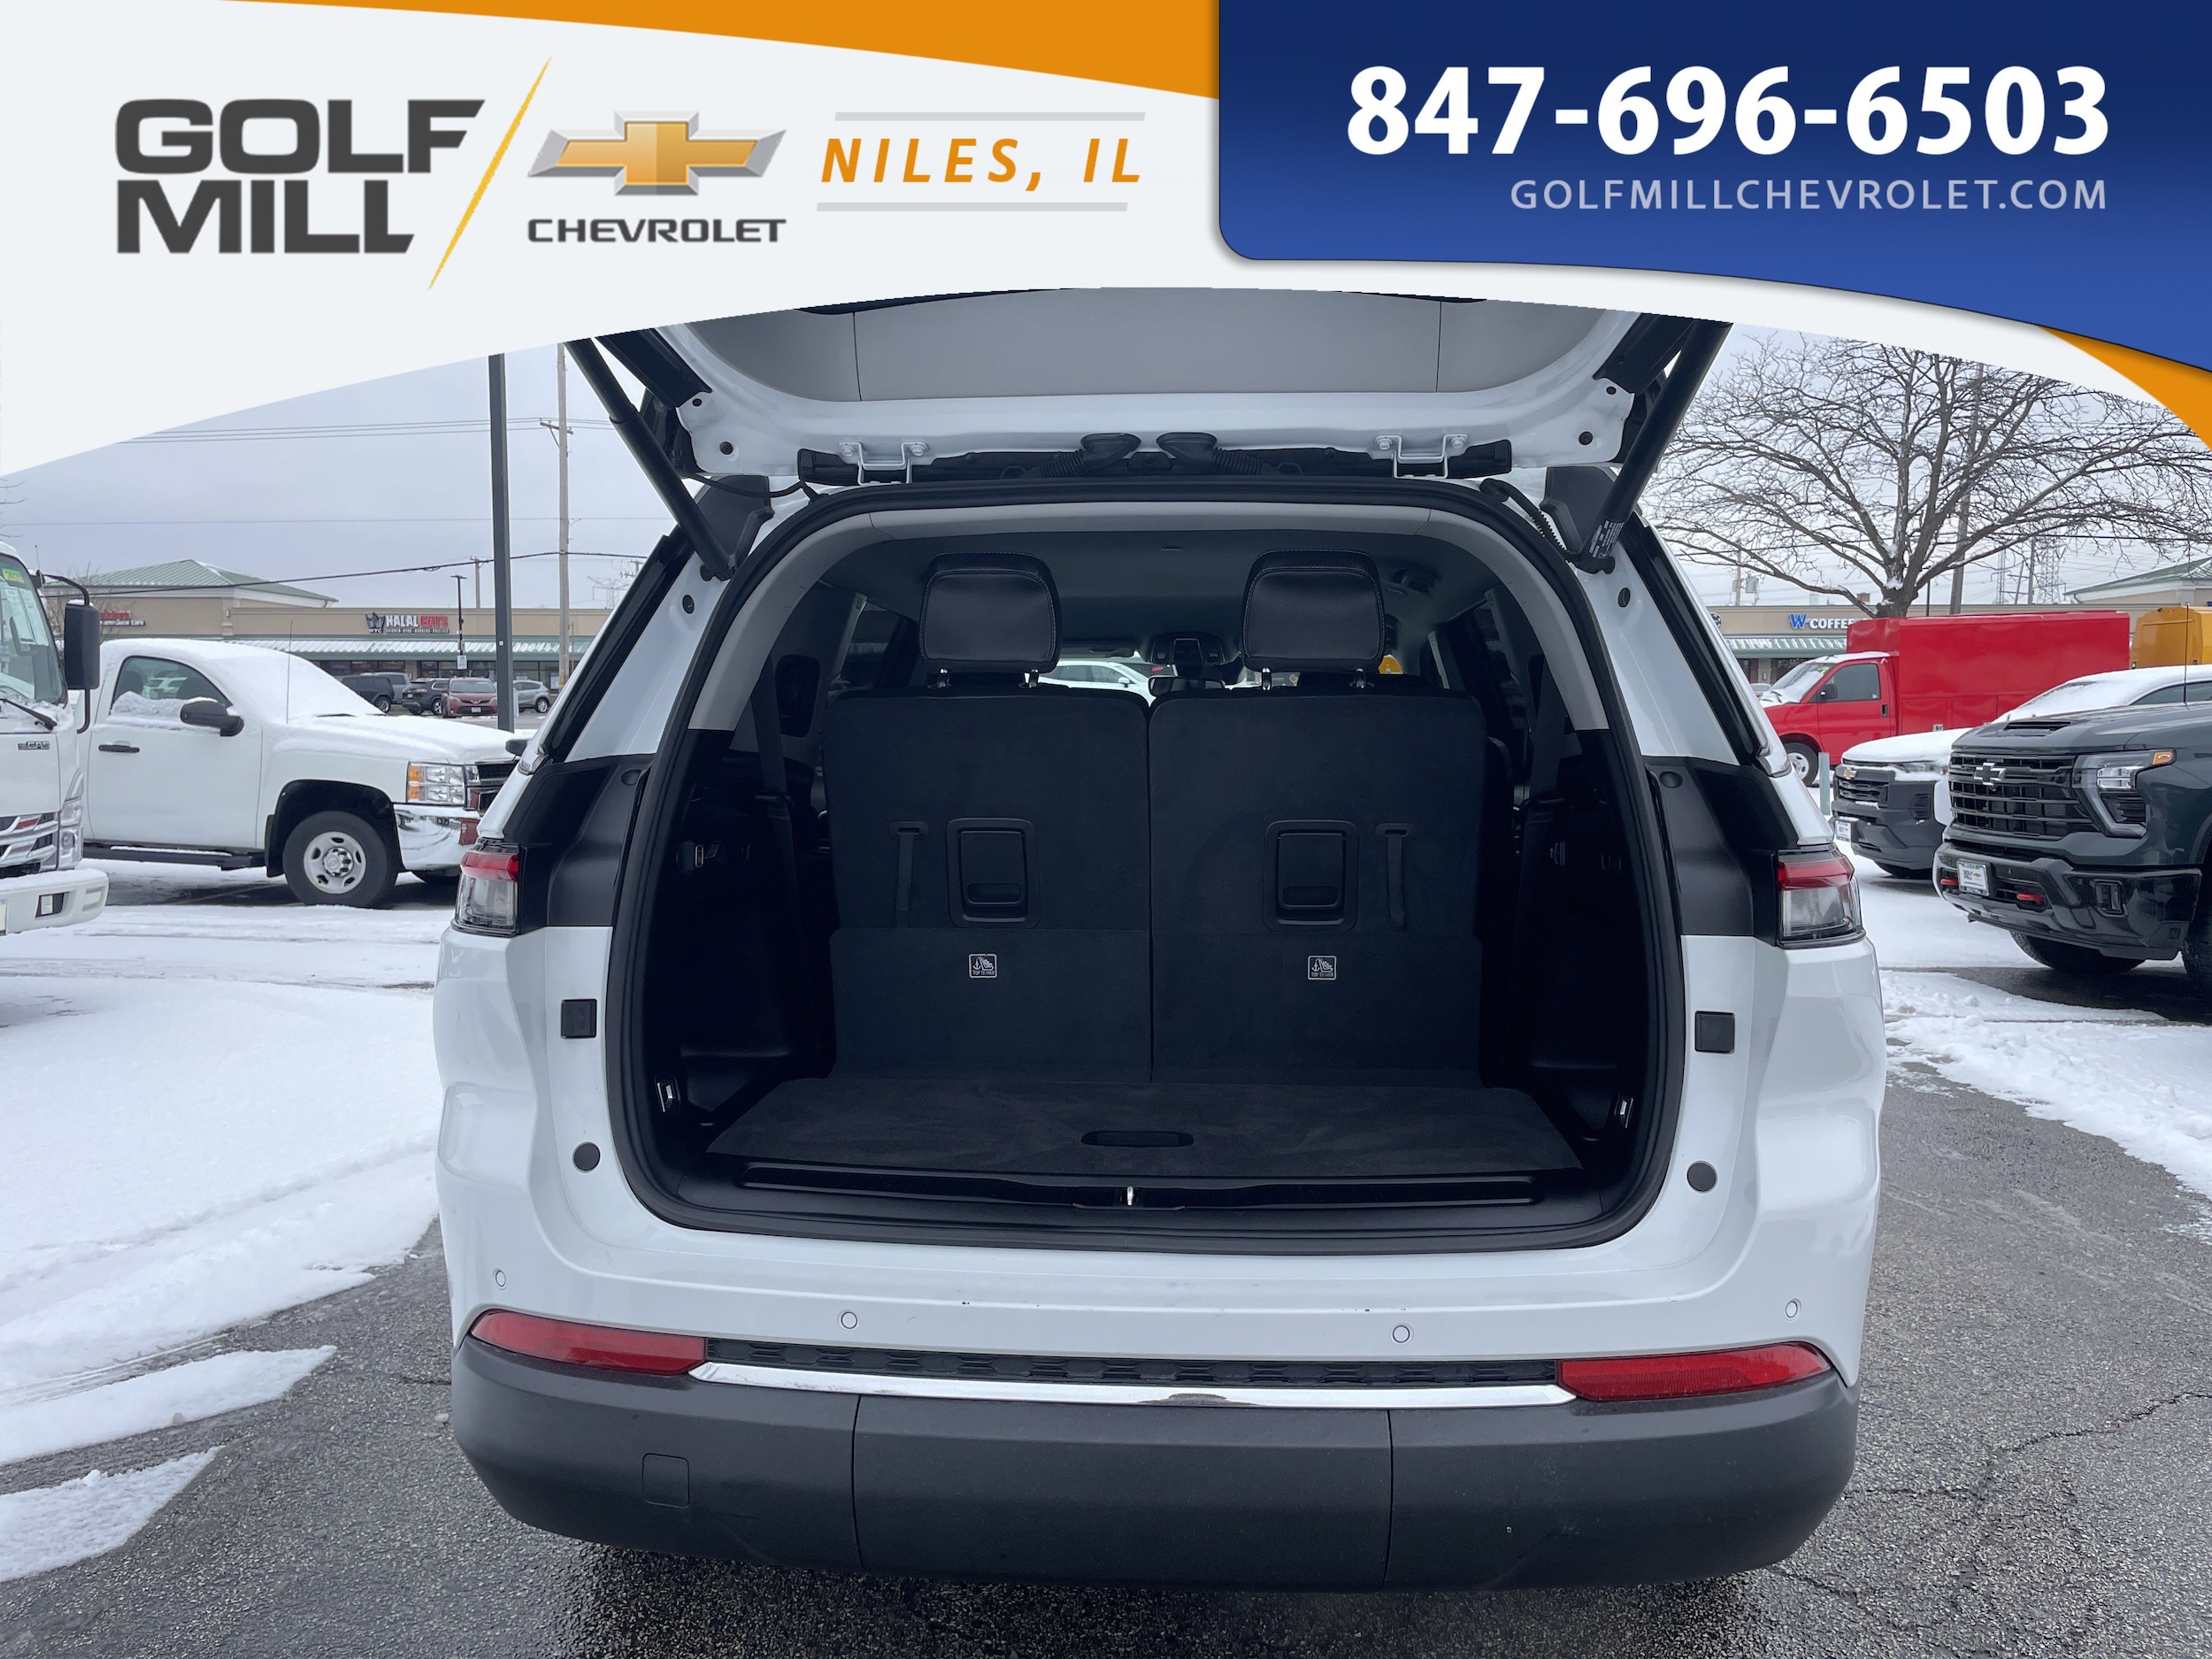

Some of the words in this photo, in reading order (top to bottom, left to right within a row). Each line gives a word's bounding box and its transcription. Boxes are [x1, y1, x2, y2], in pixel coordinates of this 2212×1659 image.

[386, 615, 419, 627] HALAL
[420, 616, 449, 628] EATS
[1790, 614, 1807, 629] W
